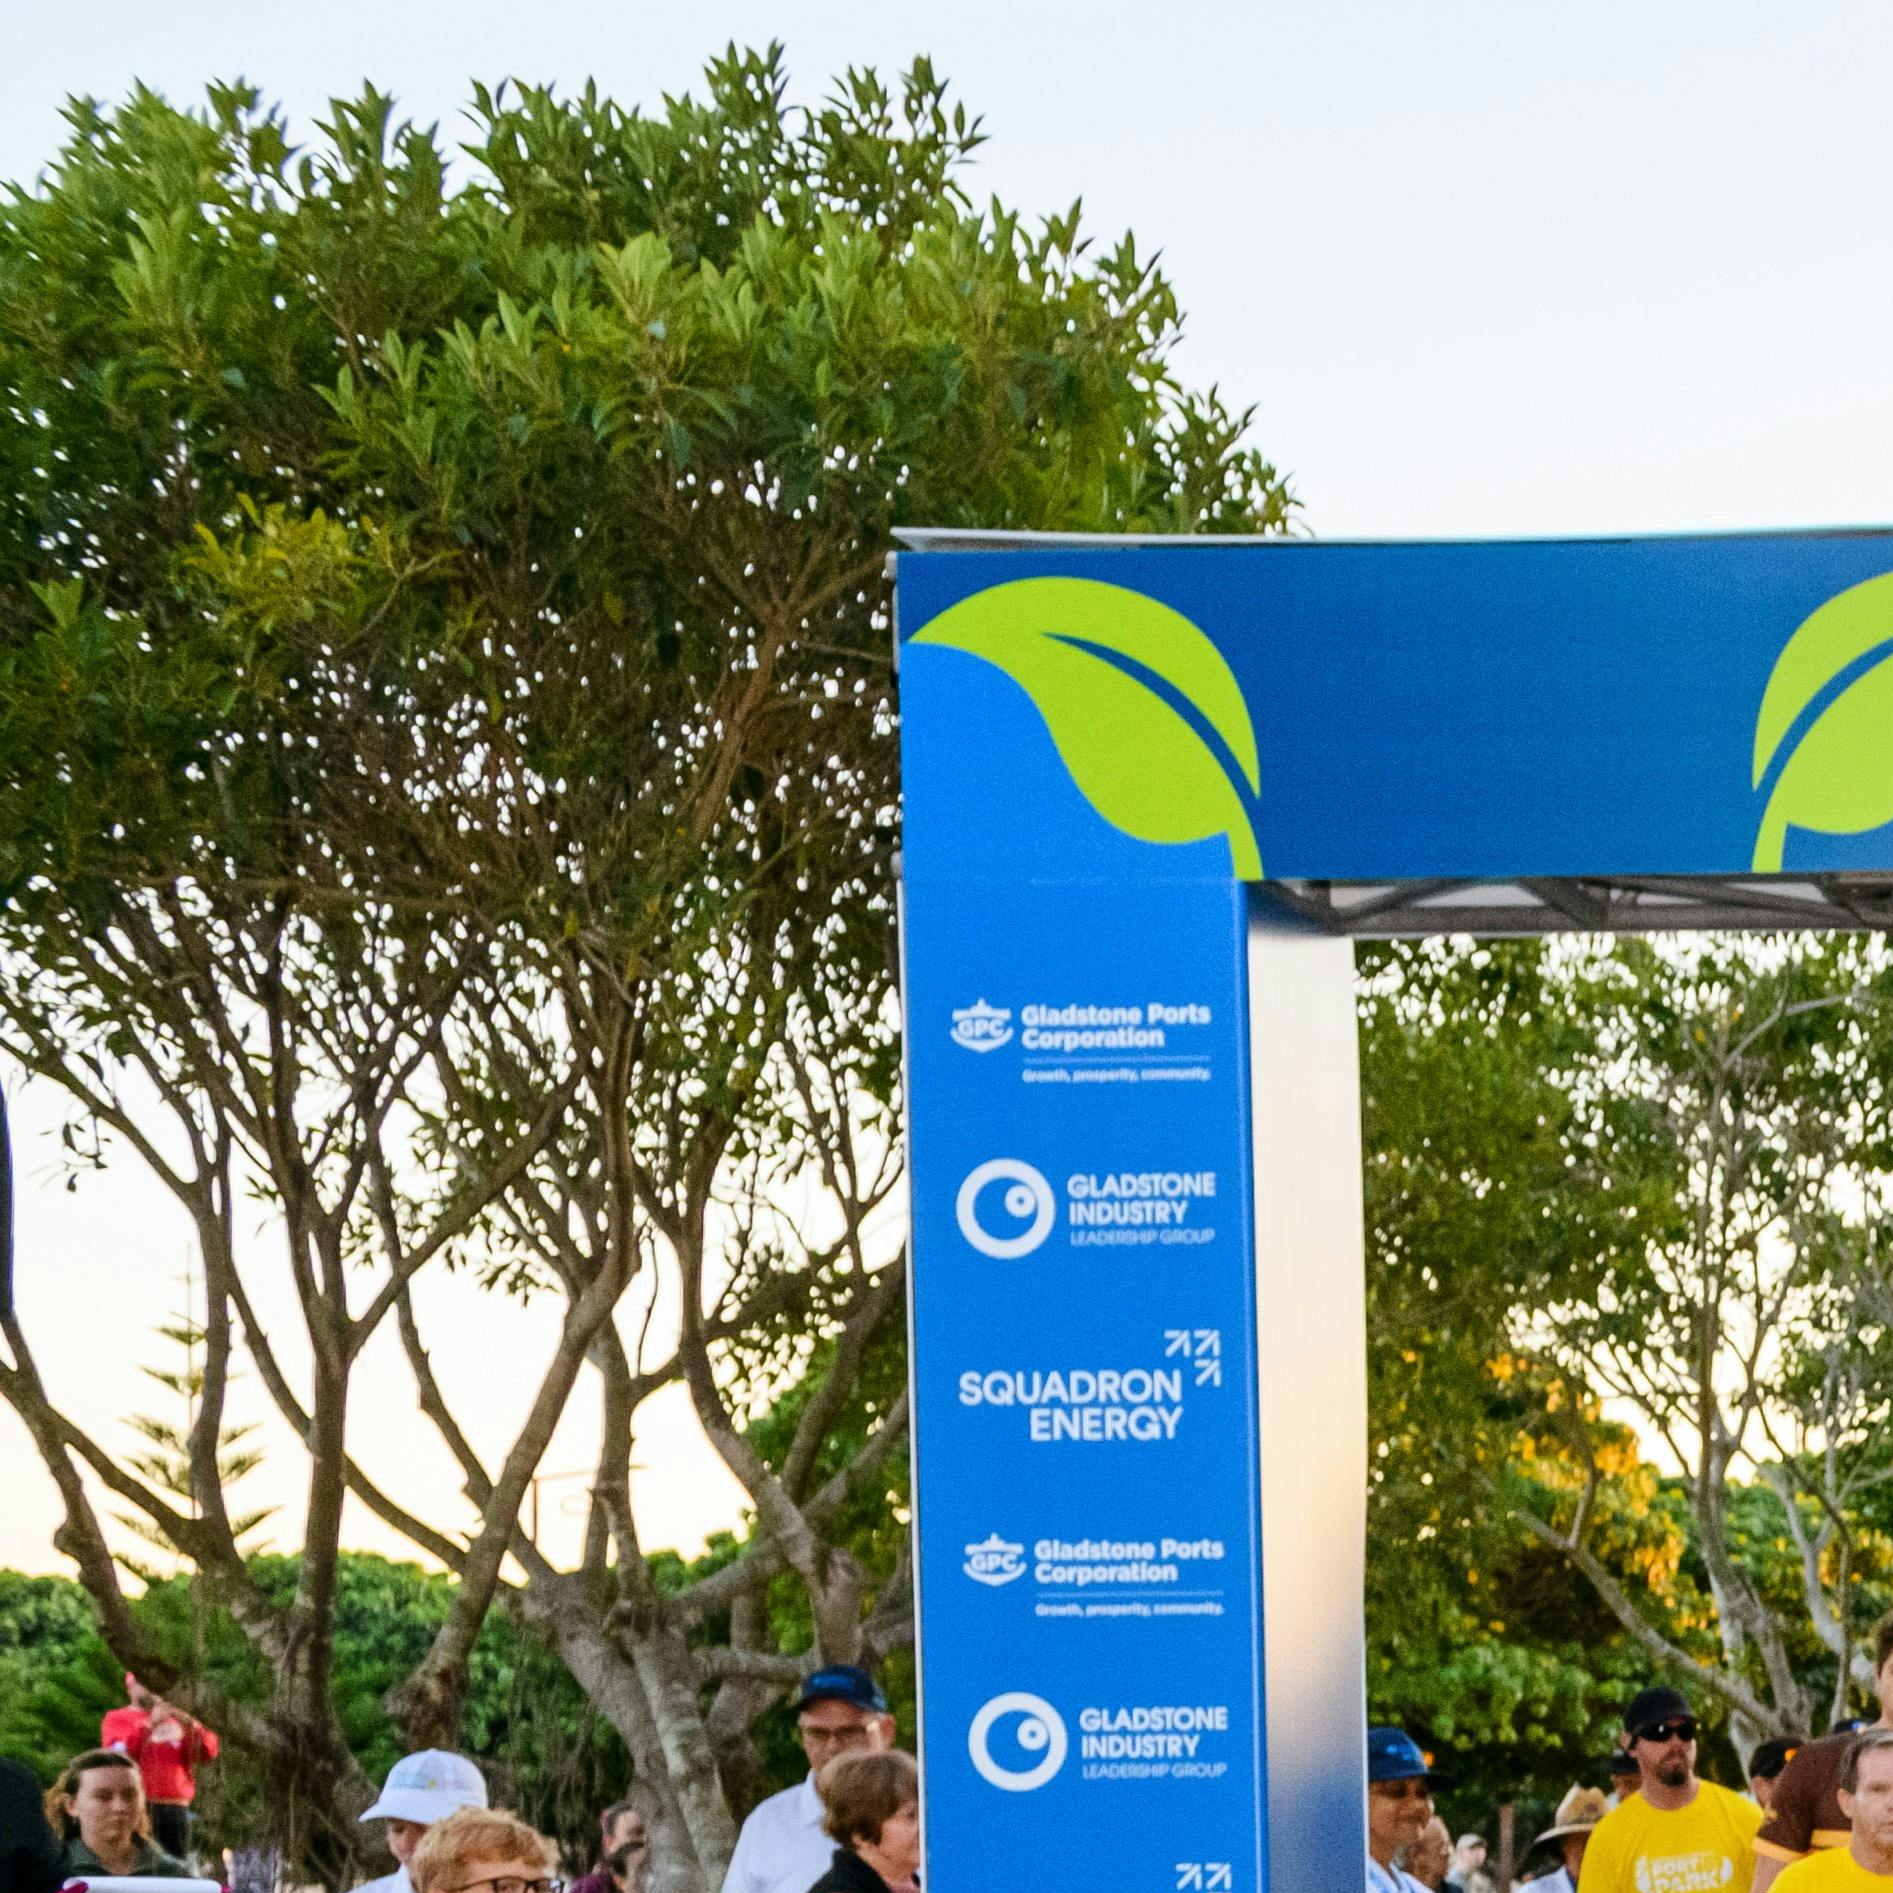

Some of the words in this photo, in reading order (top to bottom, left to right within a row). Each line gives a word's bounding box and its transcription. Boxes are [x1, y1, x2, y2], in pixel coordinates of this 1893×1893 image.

[1020, 1004, 1142, 1026] Gladstone
[1147, 1002, 1212, 1025] Ports
[957, 1018, 1004, 1037] GPC
[1020, 1026, 1165, 1052] Corporation
[1067, 1171, 1217, 1198] GLADSTONE
[1069, 1200, 1189, 1226] INDUSTRY
[958, 1368, 1182, 1407] SQUADRON
[1029, 1406, 1184, 1442] ENERGY
[1034, 1538, 1156, 1561] Gladstone
[1160, 1537, 1225, 1560] Ports
[970, 1553, 1017, 1572] GPC
[1034, 1561, 1179, 1587] Corporation
[1079, 1706, 1229, 1734] GLADSTONE
[1080, 1733, 1200, 1760] INDUSTRY
